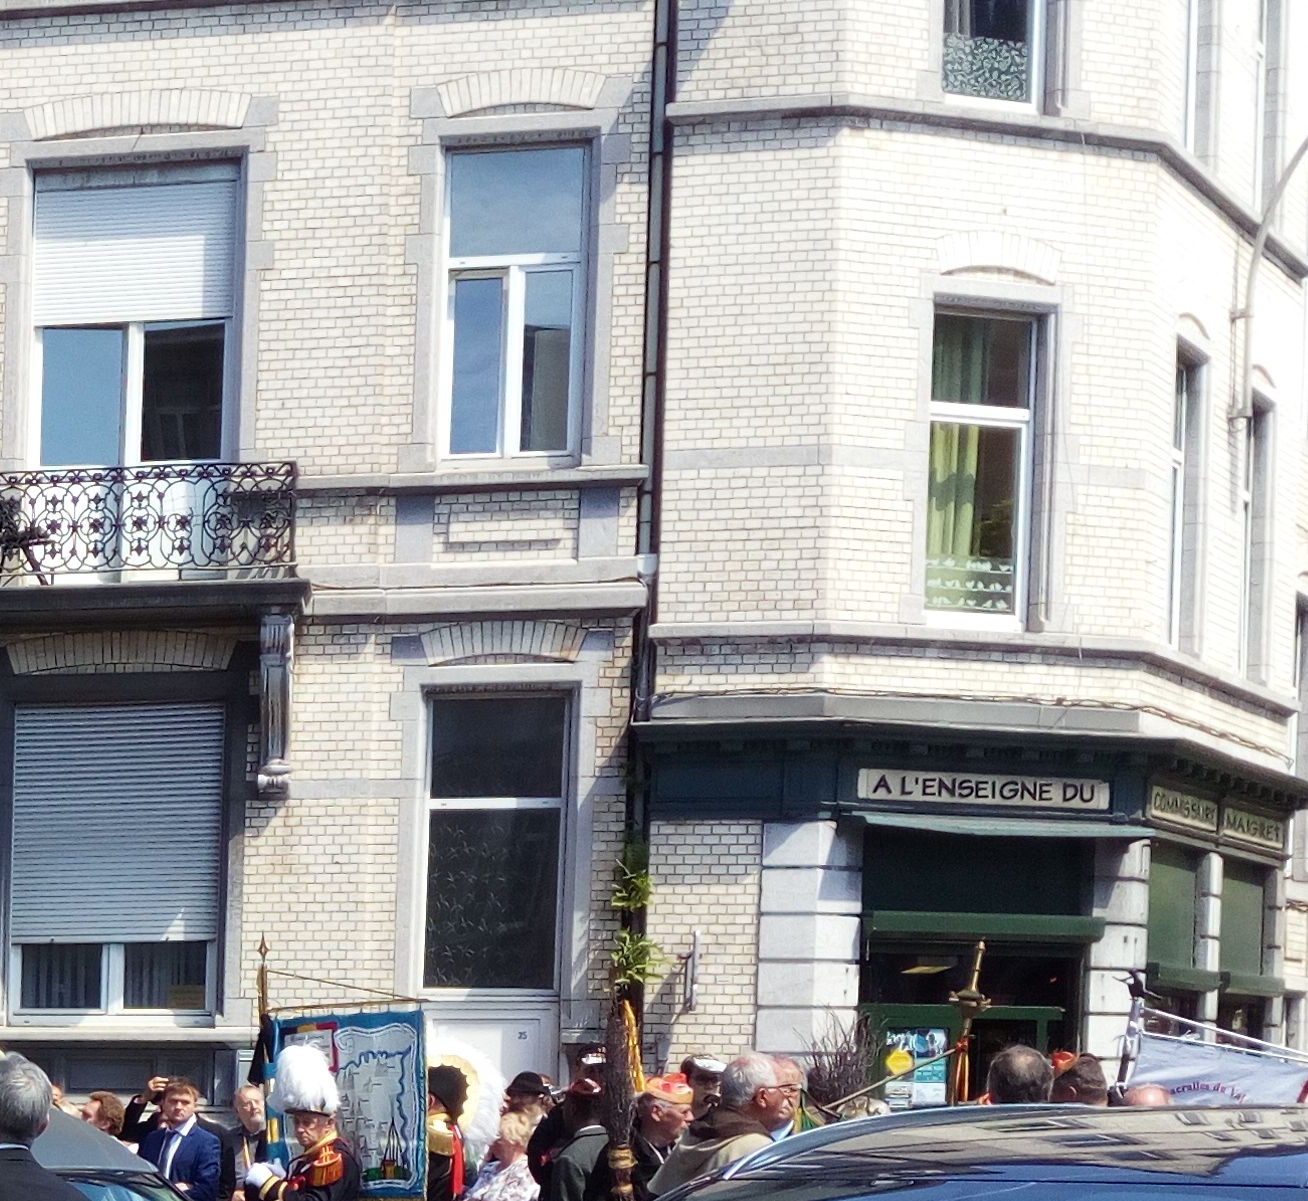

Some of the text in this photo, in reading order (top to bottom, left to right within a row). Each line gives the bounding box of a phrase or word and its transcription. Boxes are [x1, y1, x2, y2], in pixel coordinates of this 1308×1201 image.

[872, 774, 1096, 803] A L'ENSEIGNE DU
[1225, 813, 1282, 840] MAIGRET
